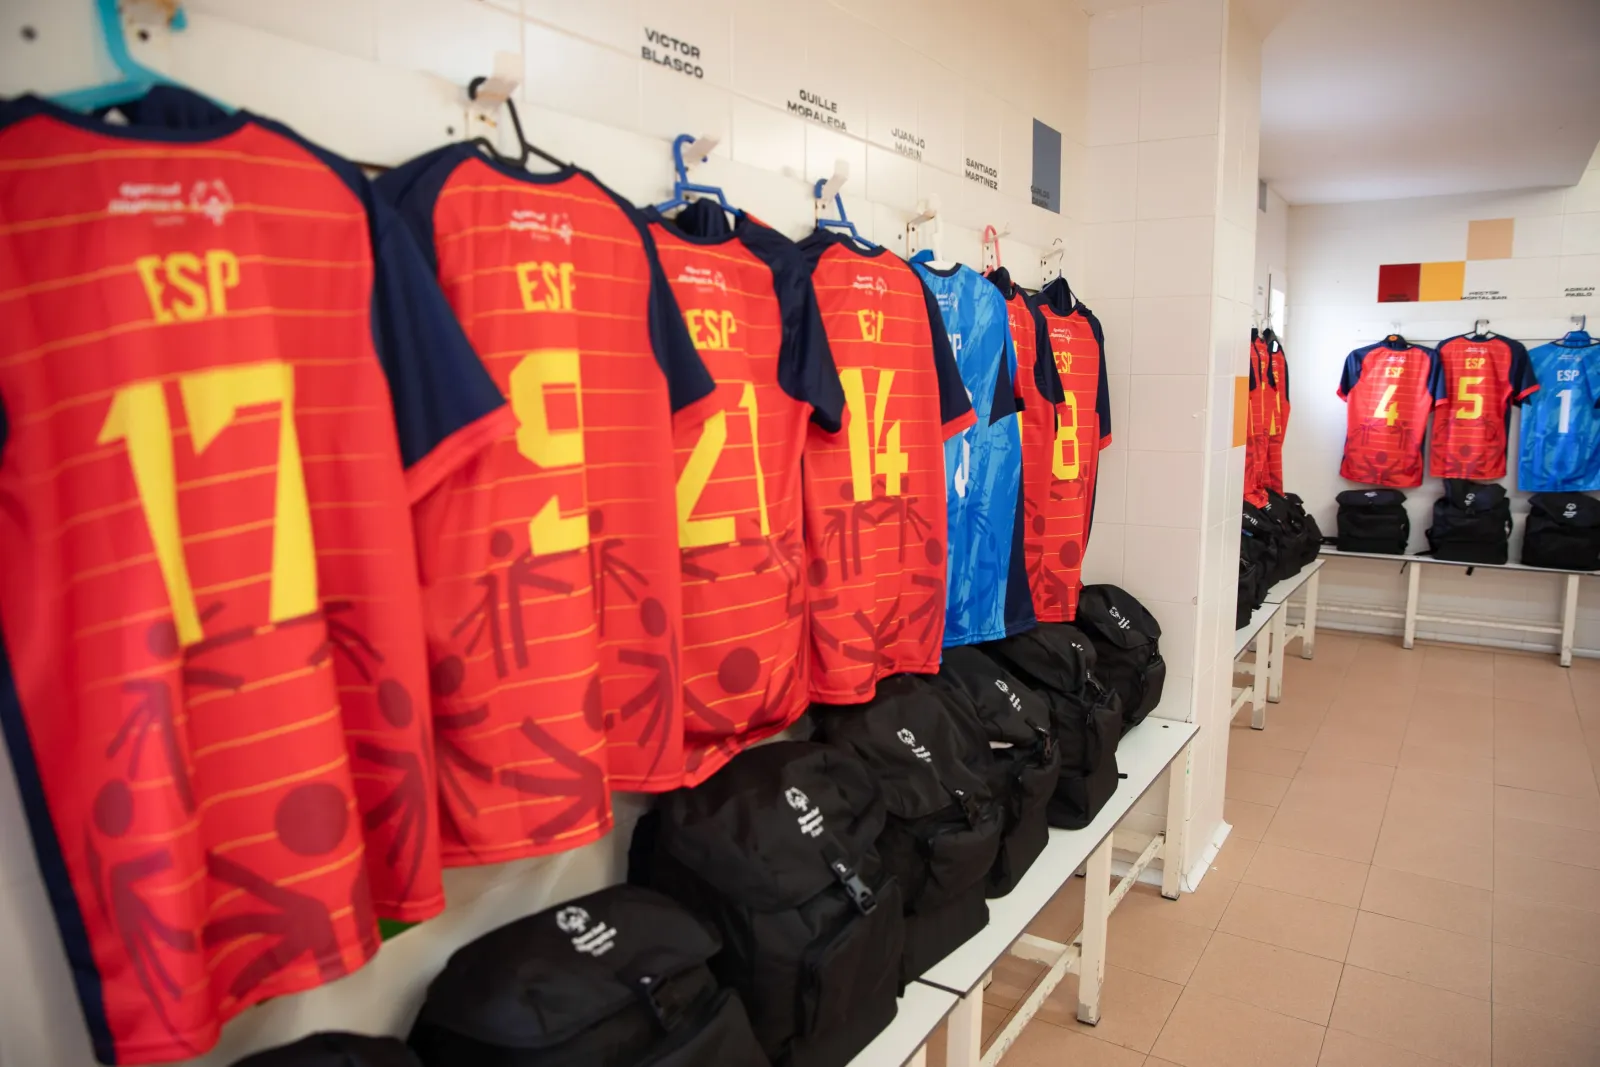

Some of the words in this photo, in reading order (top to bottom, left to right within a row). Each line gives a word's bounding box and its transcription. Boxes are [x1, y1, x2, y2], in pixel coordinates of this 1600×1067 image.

[641, 46, 704, 79] BLASCO
[644, 27, 701, 60] VICTOR
[787, 100, 847, 132] MORALEDA
[964, 170, 998, 190] MARTINEZ
[965, 158, 998, 178] SANTIAGO
[136, 250, 240, 324] ESP
[685, 309, 736, 349] ESP
[1385, 366, 1404, 378] ESP
[1465, 357, 1485, 369] ESP
[1556, 369, 1580, 381] ESP
[1373, 384, 1399, 427] 4
[1455, 376, 1484, 419] 5
[1555, 389, 1572, 434] 1
[839, 368, 909, 502] 14
[1052, 391, 1080, 480] 8
[676, 382, 770, 549] 21
[96, 361, 319, 646] 17
